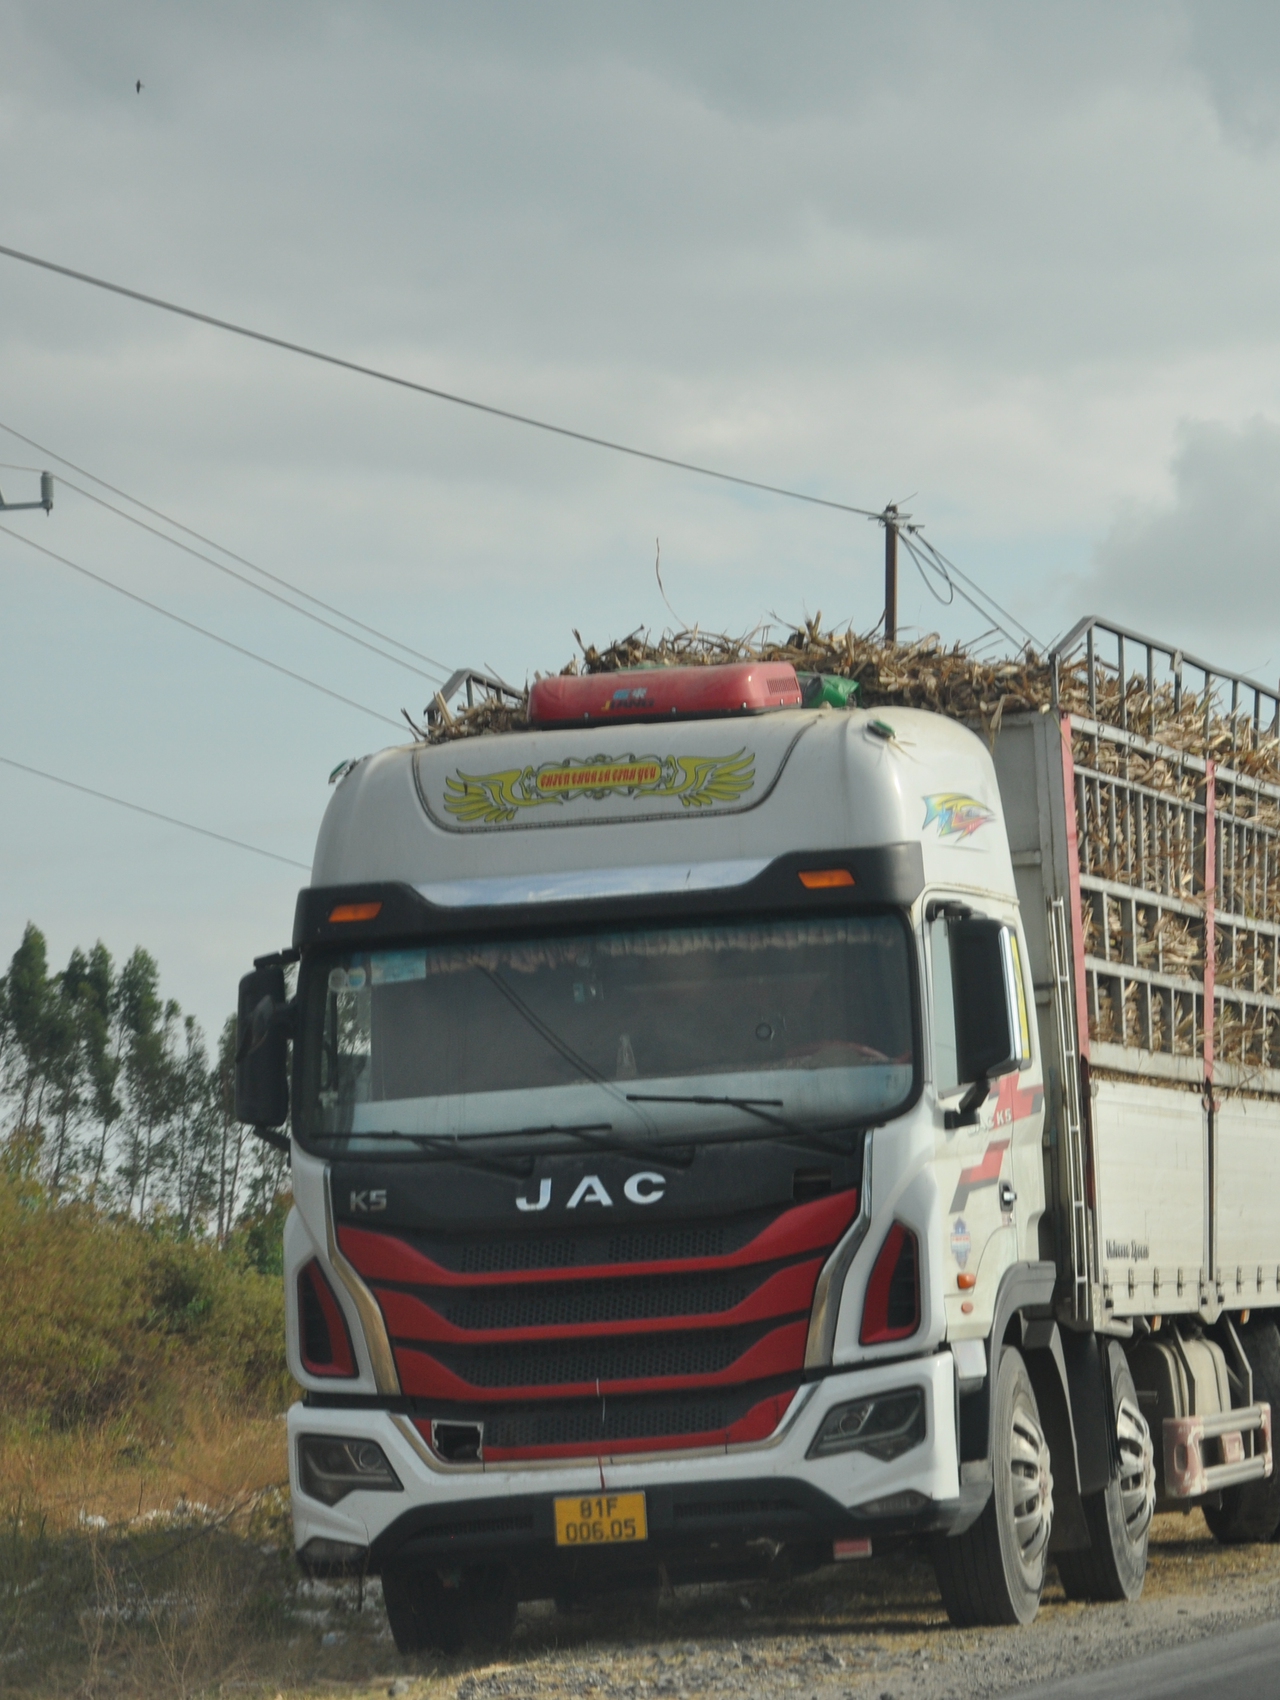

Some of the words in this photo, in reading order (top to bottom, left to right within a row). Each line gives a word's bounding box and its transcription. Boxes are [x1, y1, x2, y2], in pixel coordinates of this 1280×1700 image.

[350, 1189, 387, 1212] K5
[515, 1171, 667, 1212] JAC
[580, 1496, 618, 1519] 81F
[565, 1518, 636, 1542] 006.05
